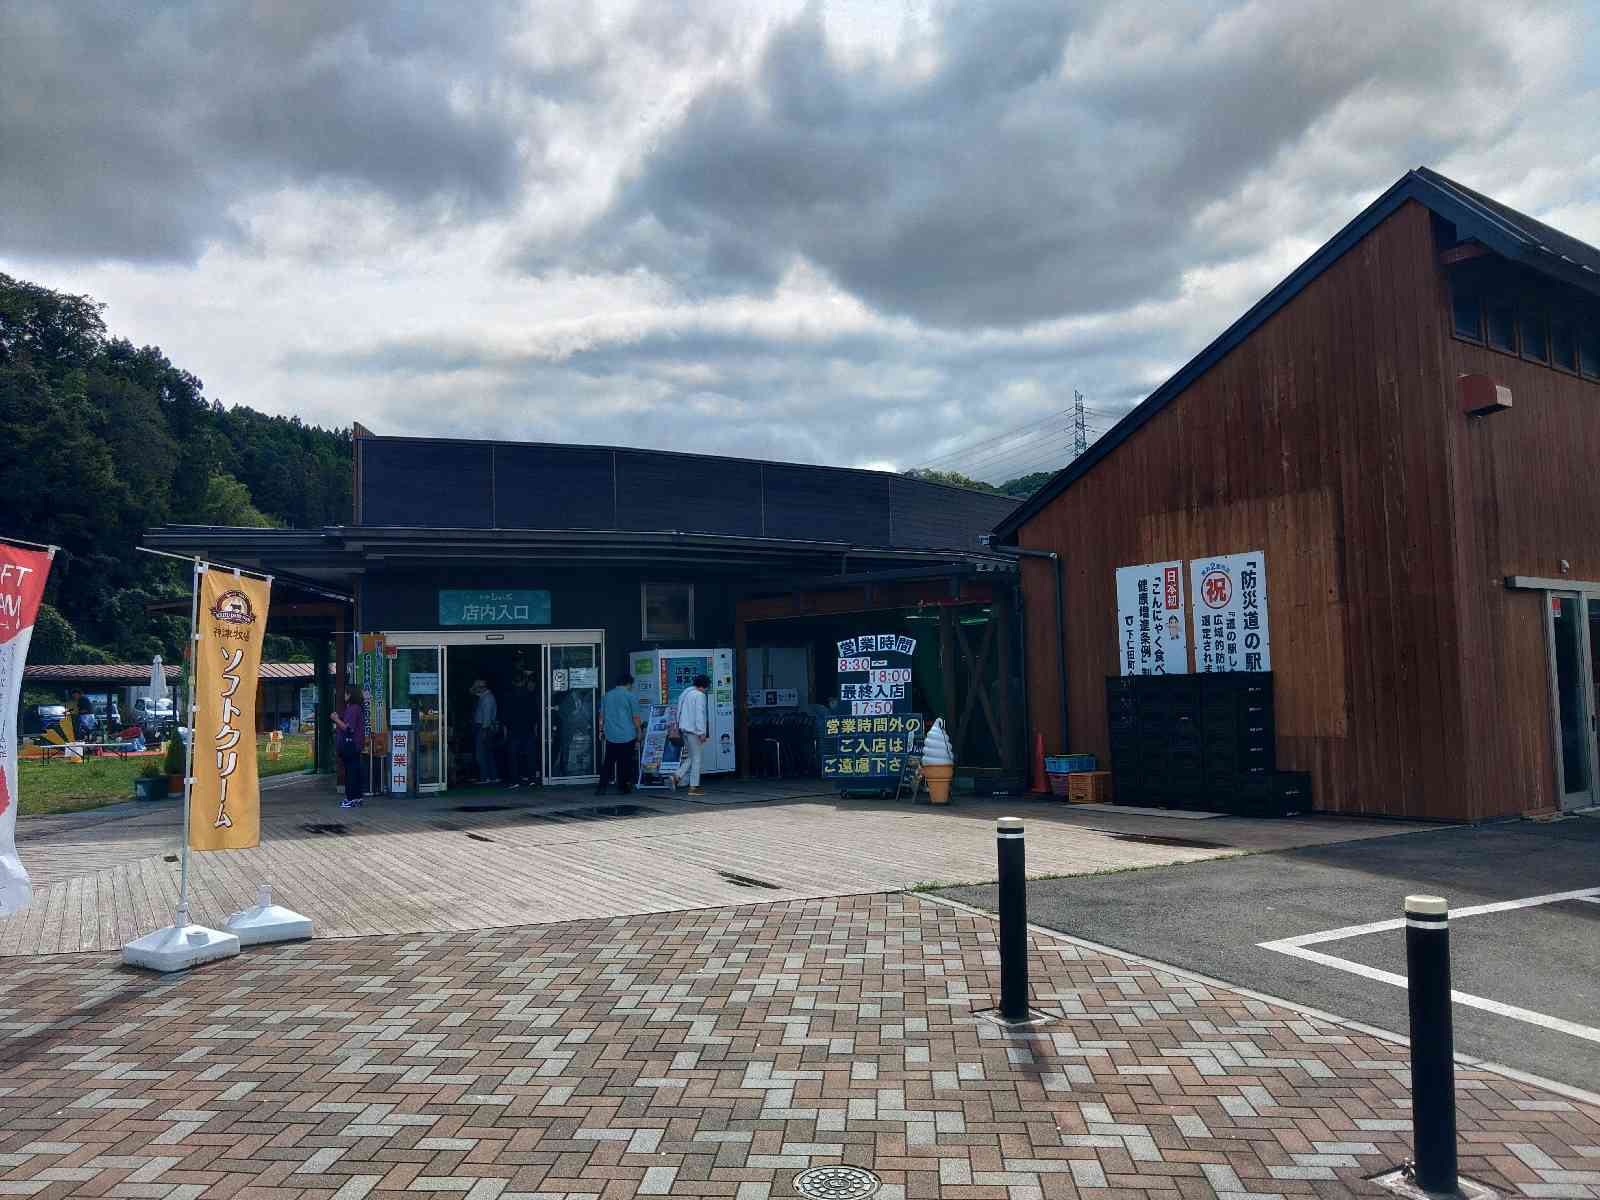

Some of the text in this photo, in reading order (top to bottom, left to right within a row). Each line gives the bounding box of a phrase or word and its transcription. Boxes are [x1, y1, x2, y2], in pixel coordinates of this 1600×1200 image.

[1167, 570, 1178, 607] 日本初
[1206, 577, 1227, 602] 祝
[462, 604, 529, 621] 店内入口
[839, 635, 913, 656] 営業時間
[1227, 611, 1237, 672] 『道の駅し
[870, 669, 911, 682] 18:00
[841, 684, 903, 699] 最終入店
[853, 702, 892, 714] 17:50
[826, 717, 920, 734] 営業時間外の
[215, 647, 244, 829] ソフトクリーム
[840, 738, 903, 752] ご入店は
[393, 734, 407, 786] 営業中
[824, 757, 901, 773] ご遠慮下さ
